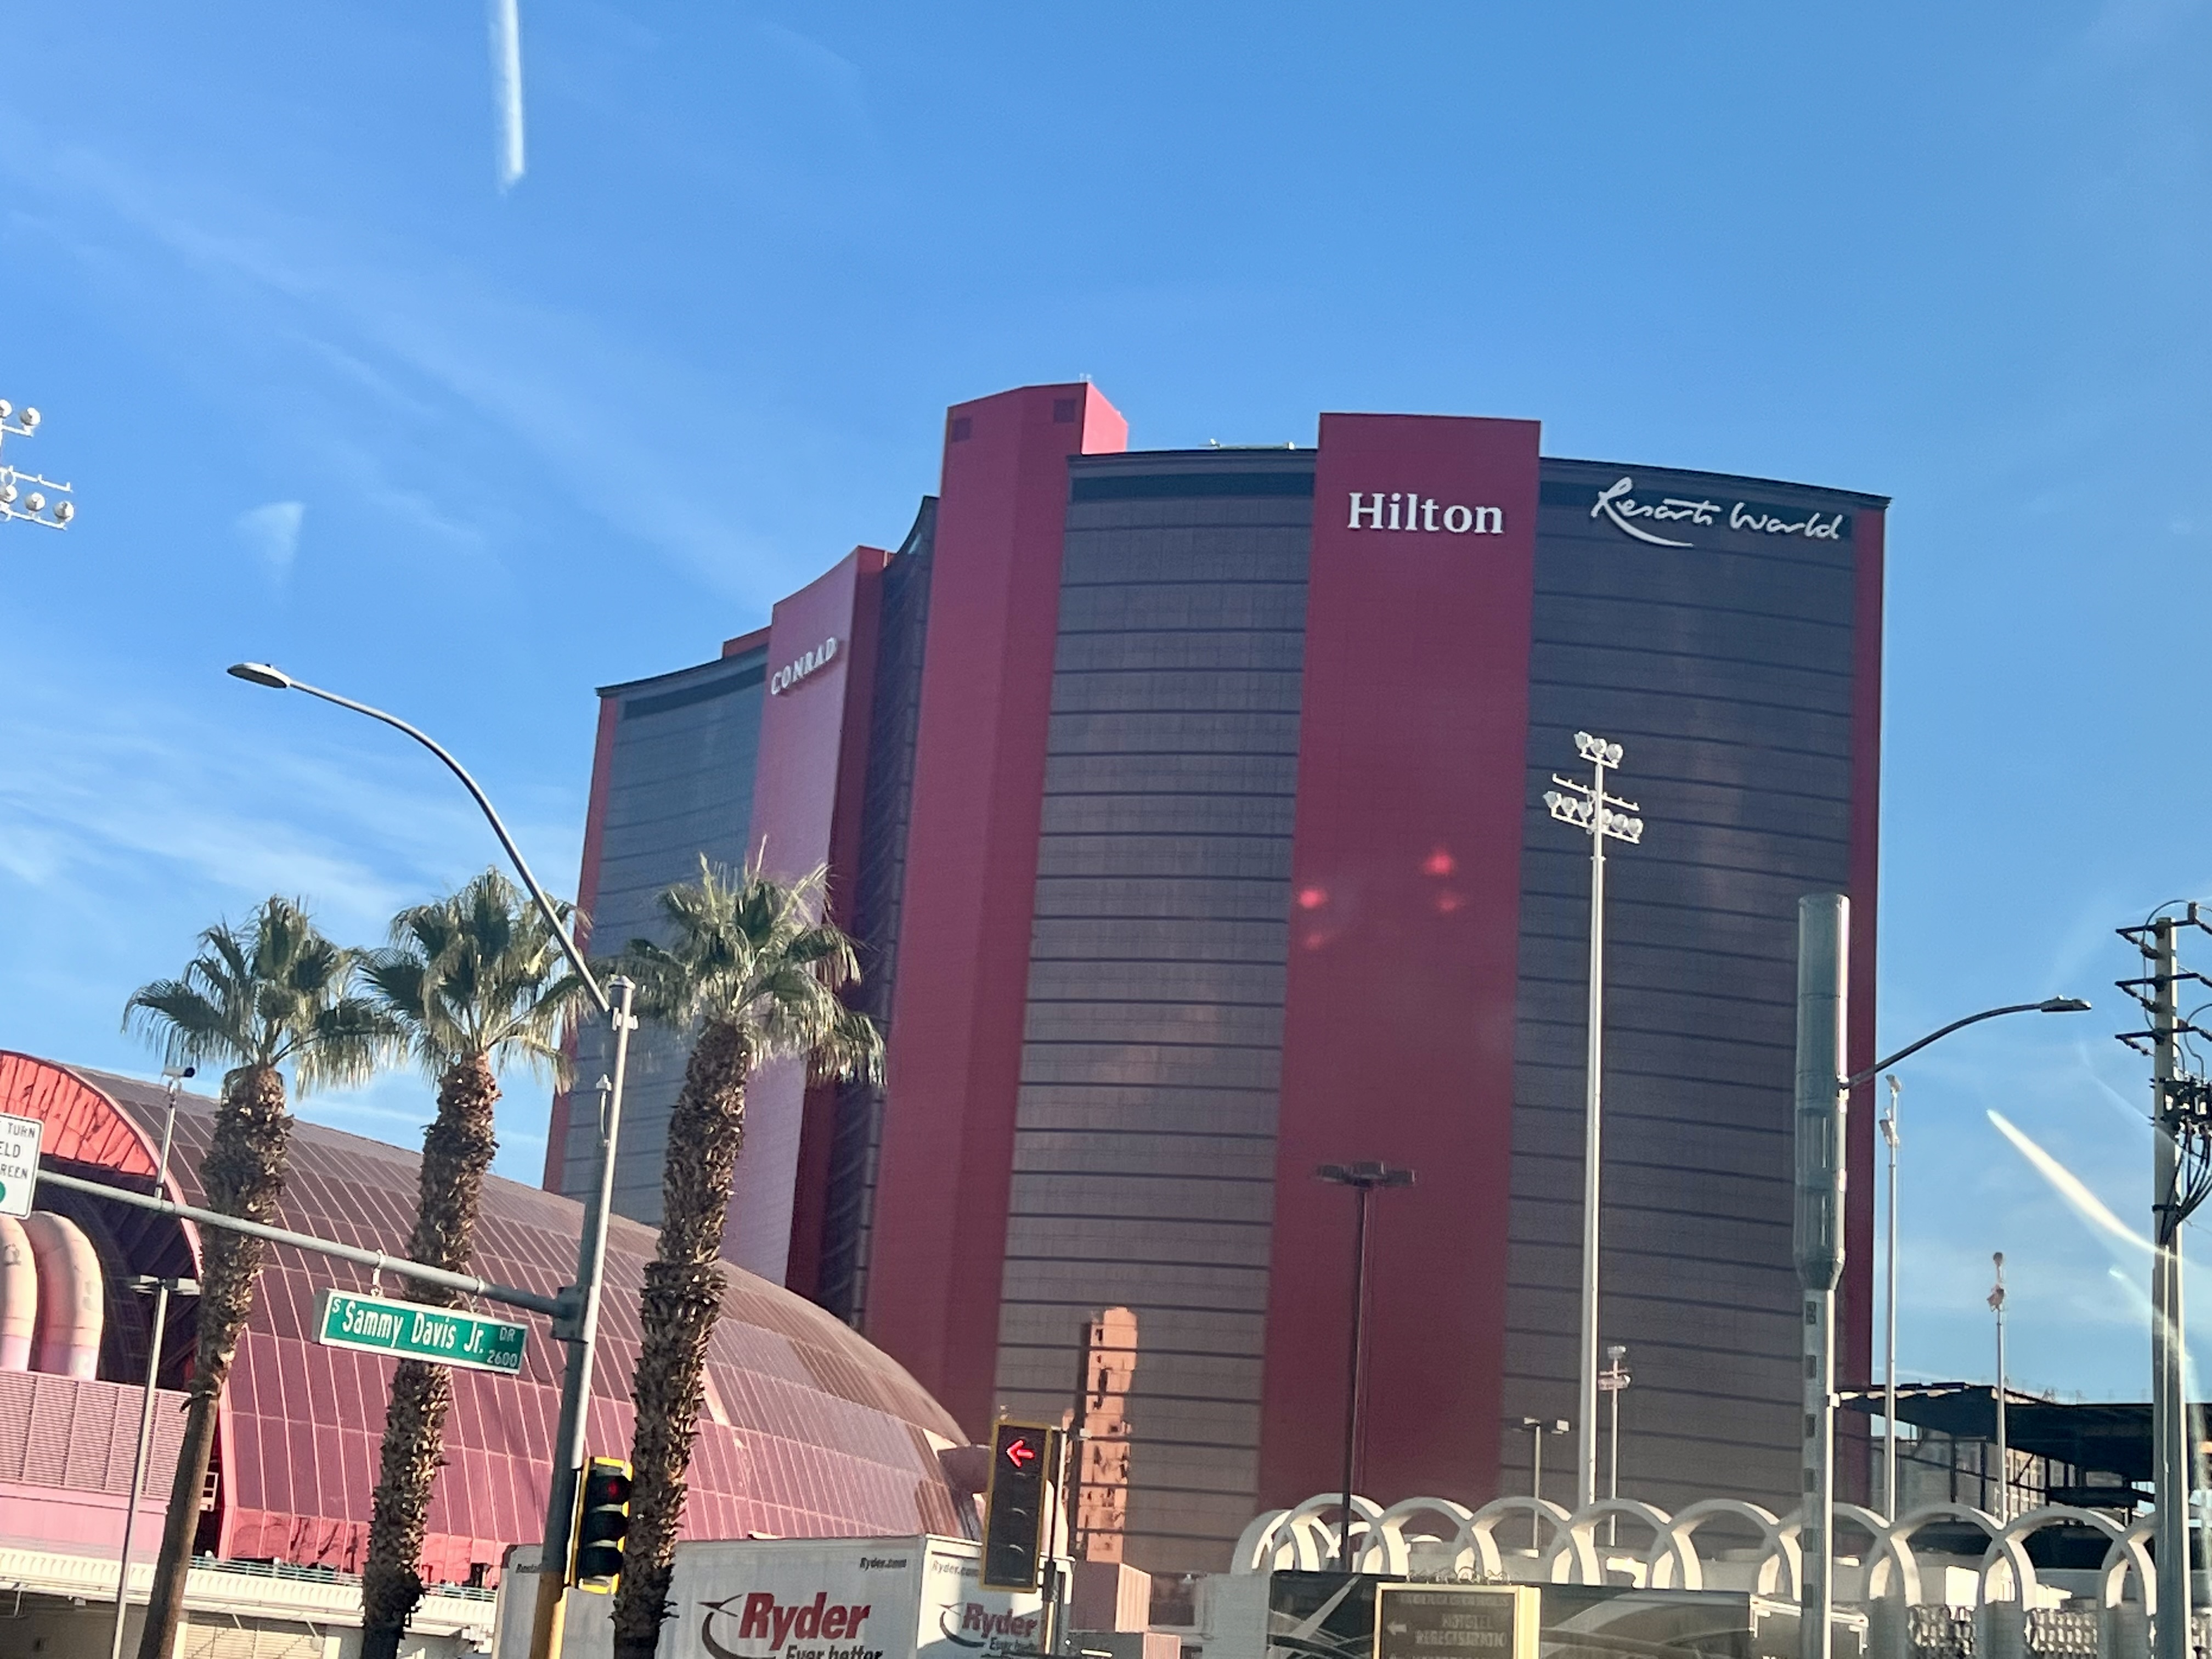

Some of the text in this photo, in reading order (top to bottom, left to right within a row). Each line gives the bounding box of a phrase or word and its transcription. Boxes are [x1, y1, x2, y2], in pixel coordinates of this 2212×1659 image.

[1347, 492, 1503, 534] Hilton
[1590, 476, 1844, 548] Resorts World
[770, 636, 838, 695] CONRAD
[8, 1121, 35, 1139] TURN
[0, 1163, 28, 1180] REEN
[331, 1297, 516, 1354] S Sammy Davis Jr. DR
[486, 1349, 520, 1368] 2600
[738, 1592, 871, 1651] Ryder
[962, 1602, 1038, 1639] Ryder
